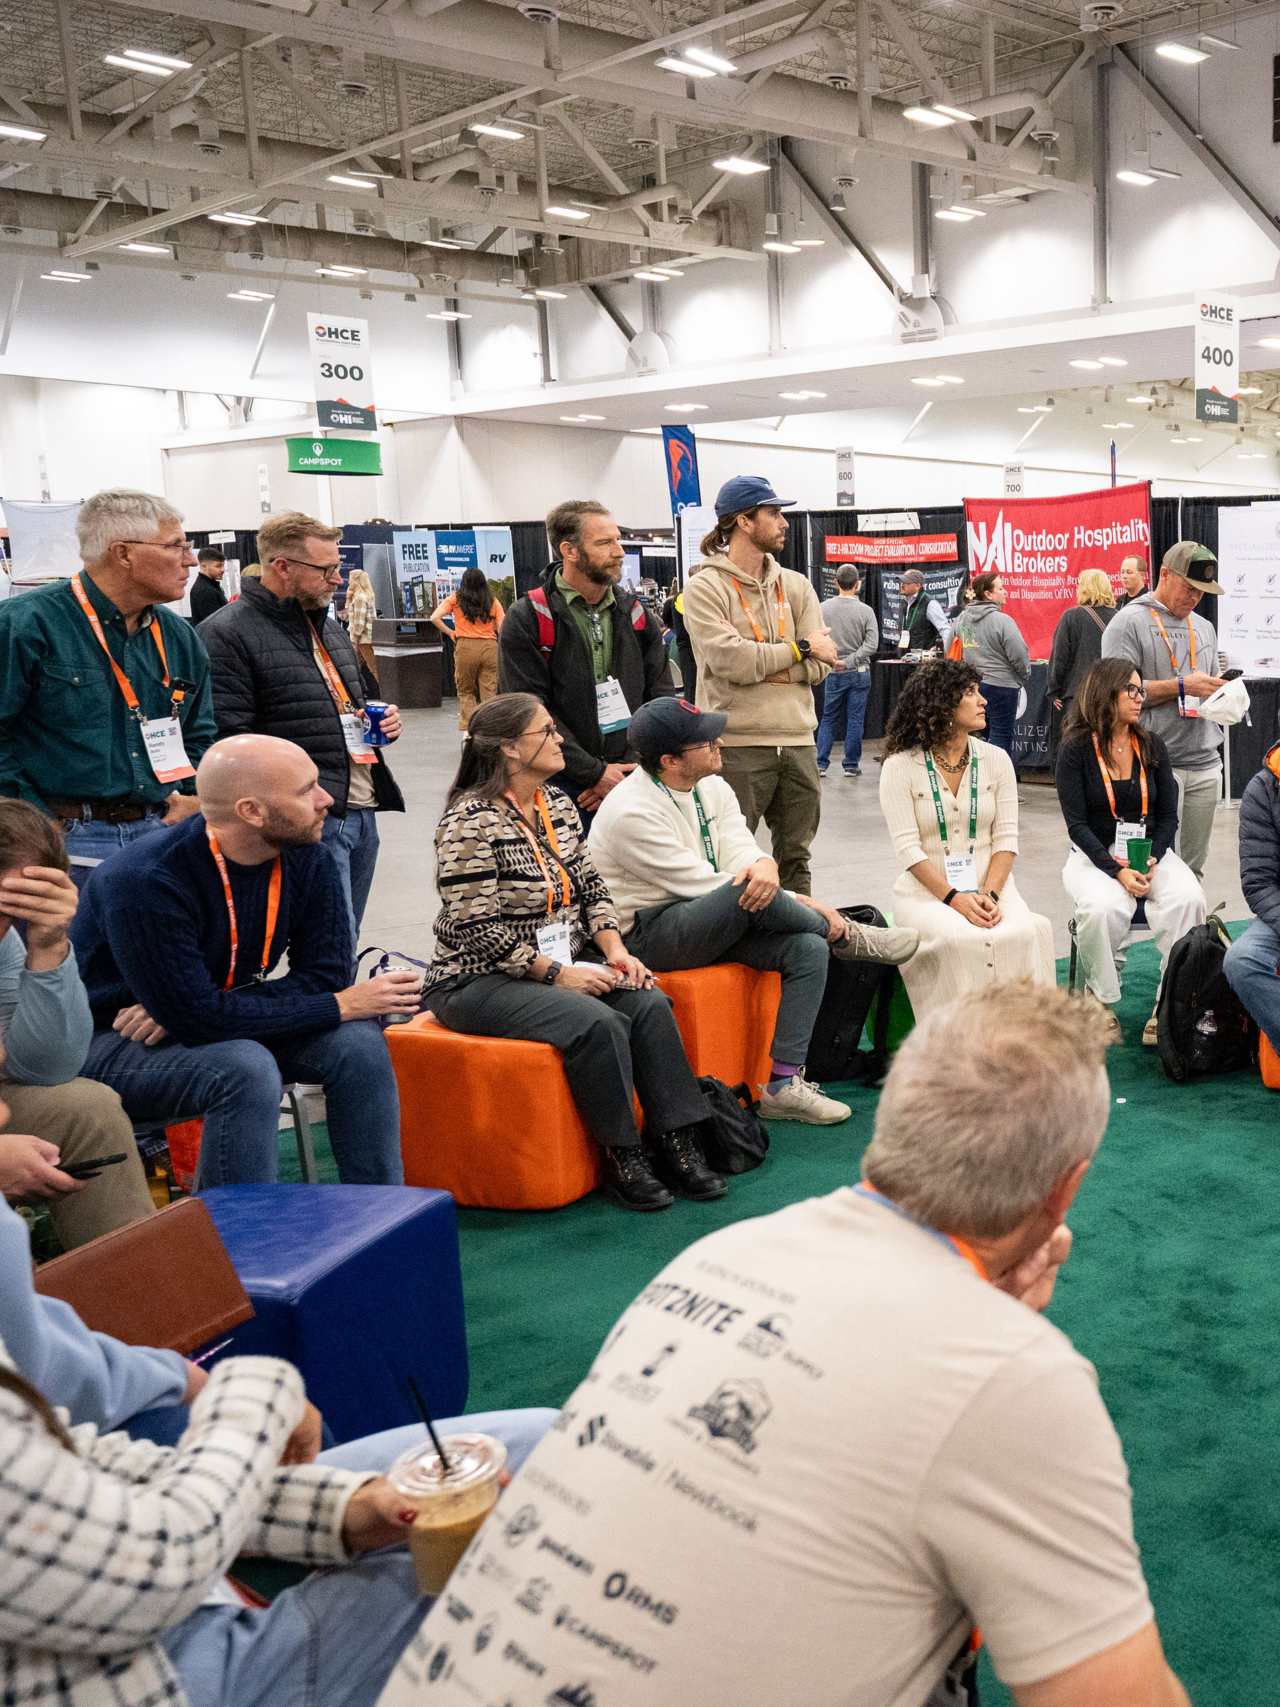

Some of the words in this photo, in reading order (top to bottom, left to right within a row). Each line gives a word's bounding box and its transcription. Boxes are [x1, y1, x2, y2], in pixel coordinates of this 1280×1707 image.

[1201, 304, 1233, 321] OHCE
[315, 326, 360, 341] OHCE
[1202, 346, 1233, 366] 400
[320, 363, 363, 381] 300
[299, 457, 342, 466] CAMPSPOT
[838, 472, 852, 481] 600
[1006, 484, 1021, 493] 700
[967, 507, 1012, 572] NAI
[1013, 528, 1069, 551] Outdoor
[1074, 518, 1150, 551] Hospitality
[402, 543, 428, 560] FREE
[826, 543, 837, 554] FREE
[919, 541, 957, 555] CONSULTATION
[1229, 542, 1280, 551] SPECIALIZED
[490, 554, 506, 562] RV
[1014, 552, 1067, 573] Brokers
[403, 563, 430, 572] PUBLICATION
[1010, 576, 1031, 586] Outdoor
[1033, 575, 1064, 588] Hospitality
[1010, 590, 1020, 598] and
[1021, 589, 1053, 600] Disposition
[1063, 588, 1073, 598] RV
[145, 730, 166, 740] OHCE
